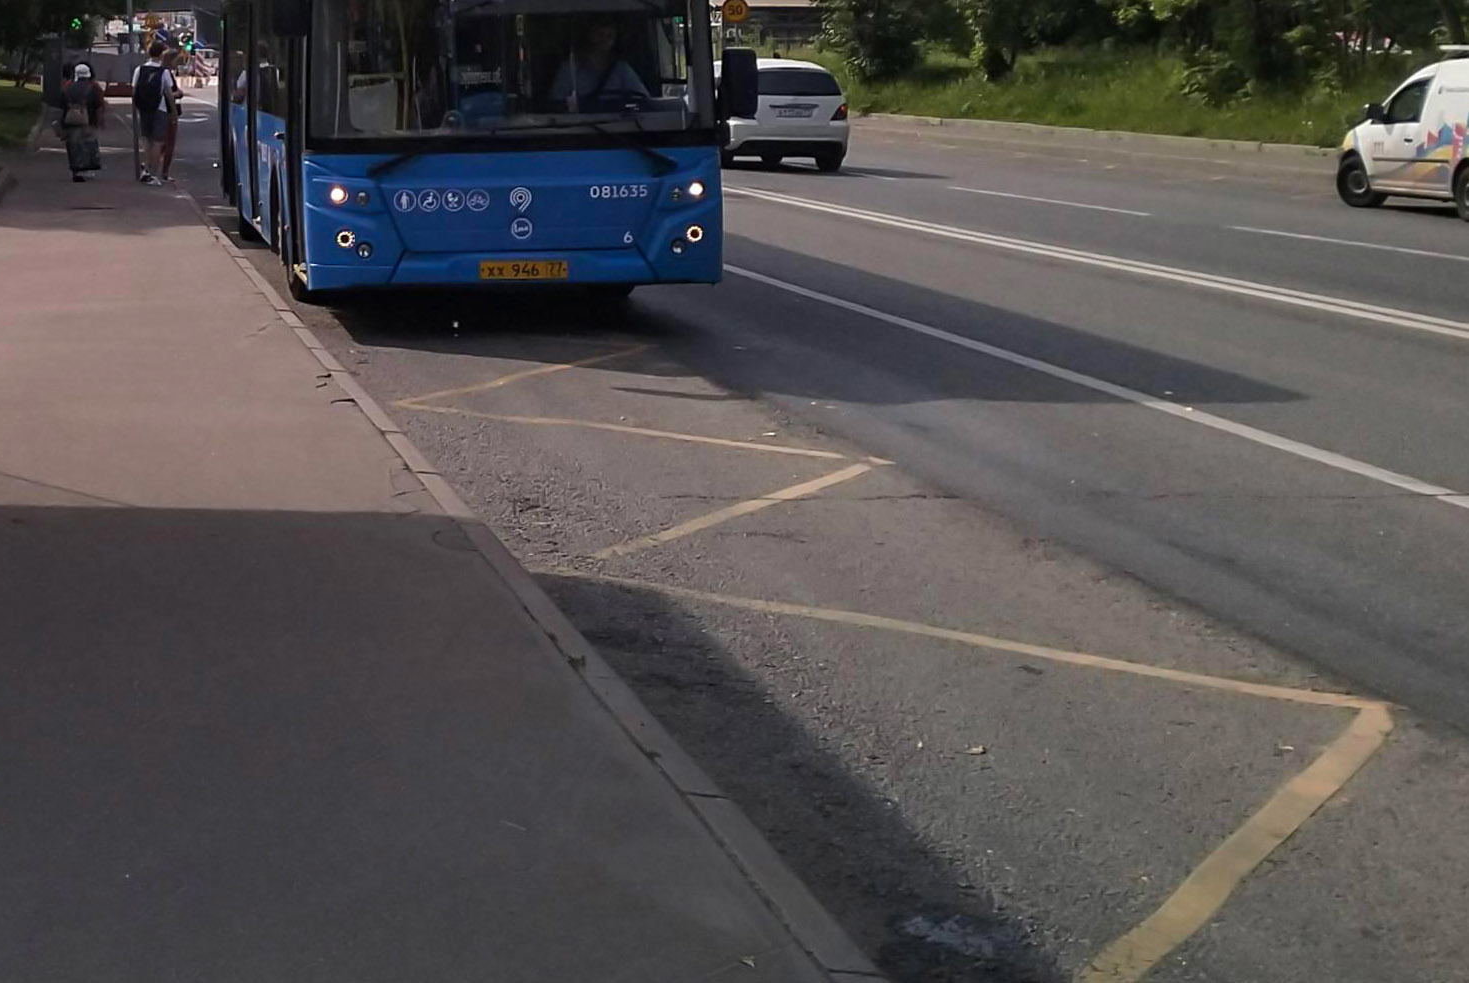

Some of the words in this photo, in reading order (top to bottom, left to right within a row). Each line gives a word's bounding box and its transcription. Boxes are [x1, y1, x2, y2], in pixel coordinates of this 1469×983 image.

[728, 5, 743, 15] 50
[589, 184, 649, 199] 081635
[623, 231, 633, 244] 6
[512, 262, 540, 278] 946
[547, 262, 563, 276] 77
